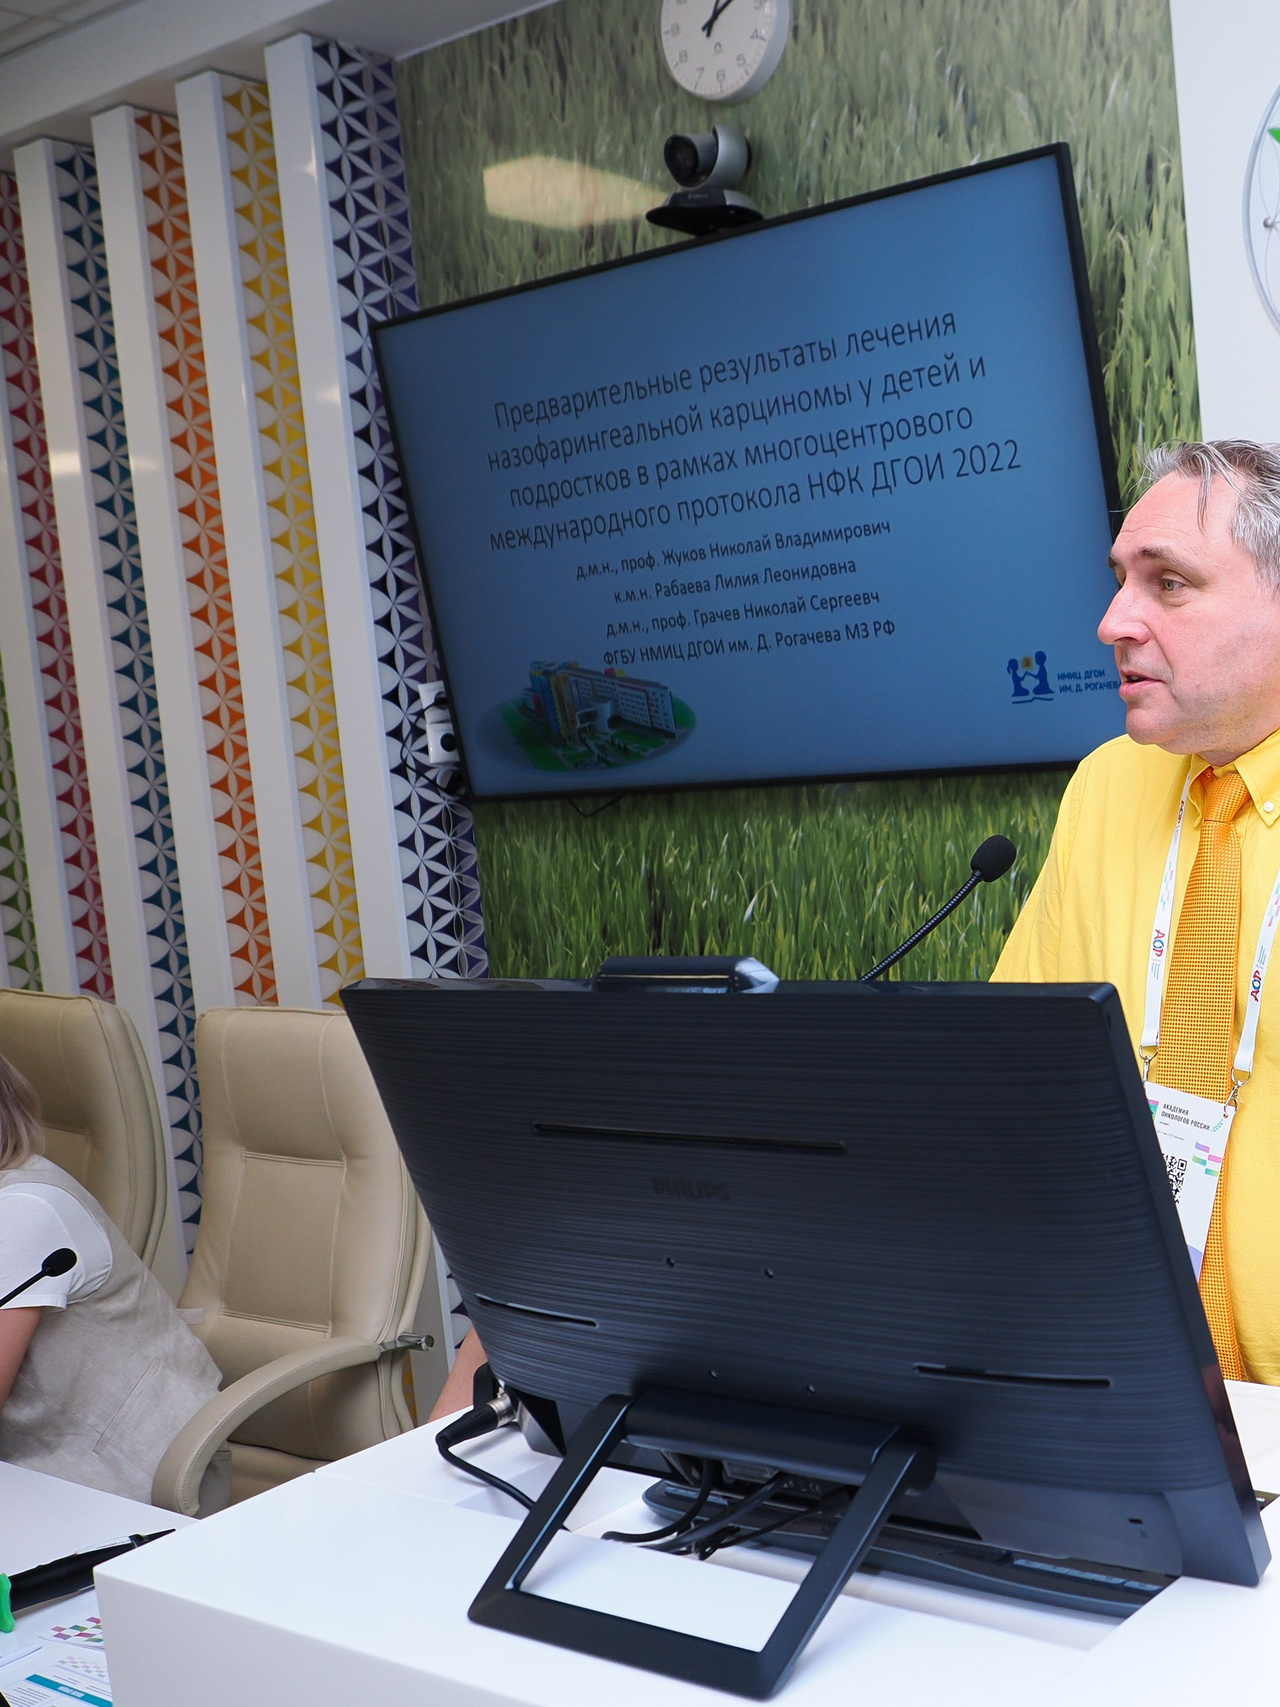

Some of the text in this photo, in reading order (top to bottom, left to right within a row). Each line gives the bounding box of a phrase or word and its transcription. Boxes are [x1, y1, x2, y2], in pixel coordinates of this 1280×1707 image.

[494, 312, 957, 432] Предварительные результаты лечения
[487, 352, 986, 472] назофарингеальной карциномы у детей и
[509, 406, 973, 508] подростков в рамках многоцентрового
[489, 439, 1022, 551] международного протокола НФК ДГОИ 2022
[575, 520, 891, 582] д.м.н., проф. Жуков Николай Владимирович
[613, 559, 857, 605] к.м.н. Рабаева Лилия Леонидовна
[605, 590, 880, 640] д.м.н., проф. Грачев Николай Сергеевч
[602, 619, 896, 666] ФГБУ НМИЦ ДГОИ им. Д. Рогачева МЗ РФ
[1161, 1110, 1210, 1131] ОНКОЛОГОВ РОССИИ
[1163, 1103, 1189, 1115] АКАДЕМИЯ
[651, 1177, 732, 1201] PHILIPS
